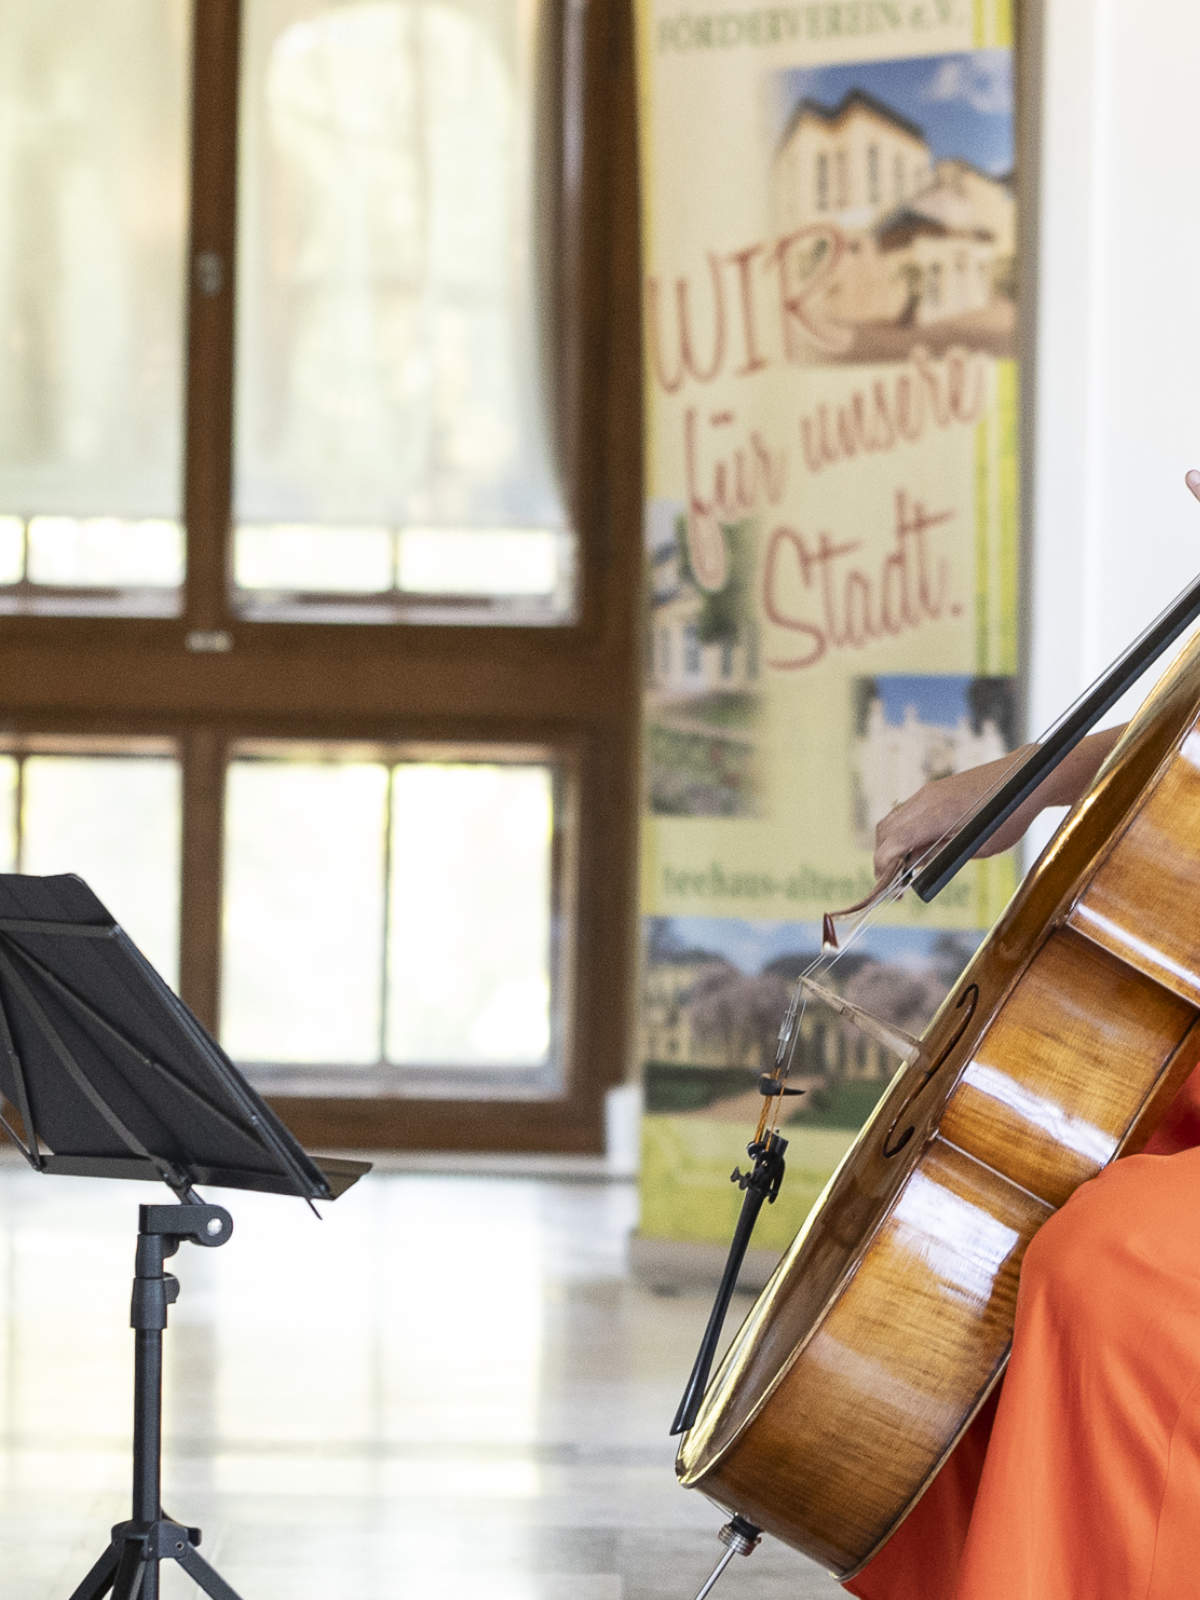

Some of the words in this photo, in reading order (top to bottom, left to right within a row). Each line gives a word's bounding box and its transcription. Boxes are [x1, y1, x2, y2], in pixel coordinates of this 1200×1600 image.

[647, 222, 858, 394] WIR
[684, 406, 789, 594] für
[800, 343, 985, 473] unsere
[763, 488, 964, 671] Stadt.
